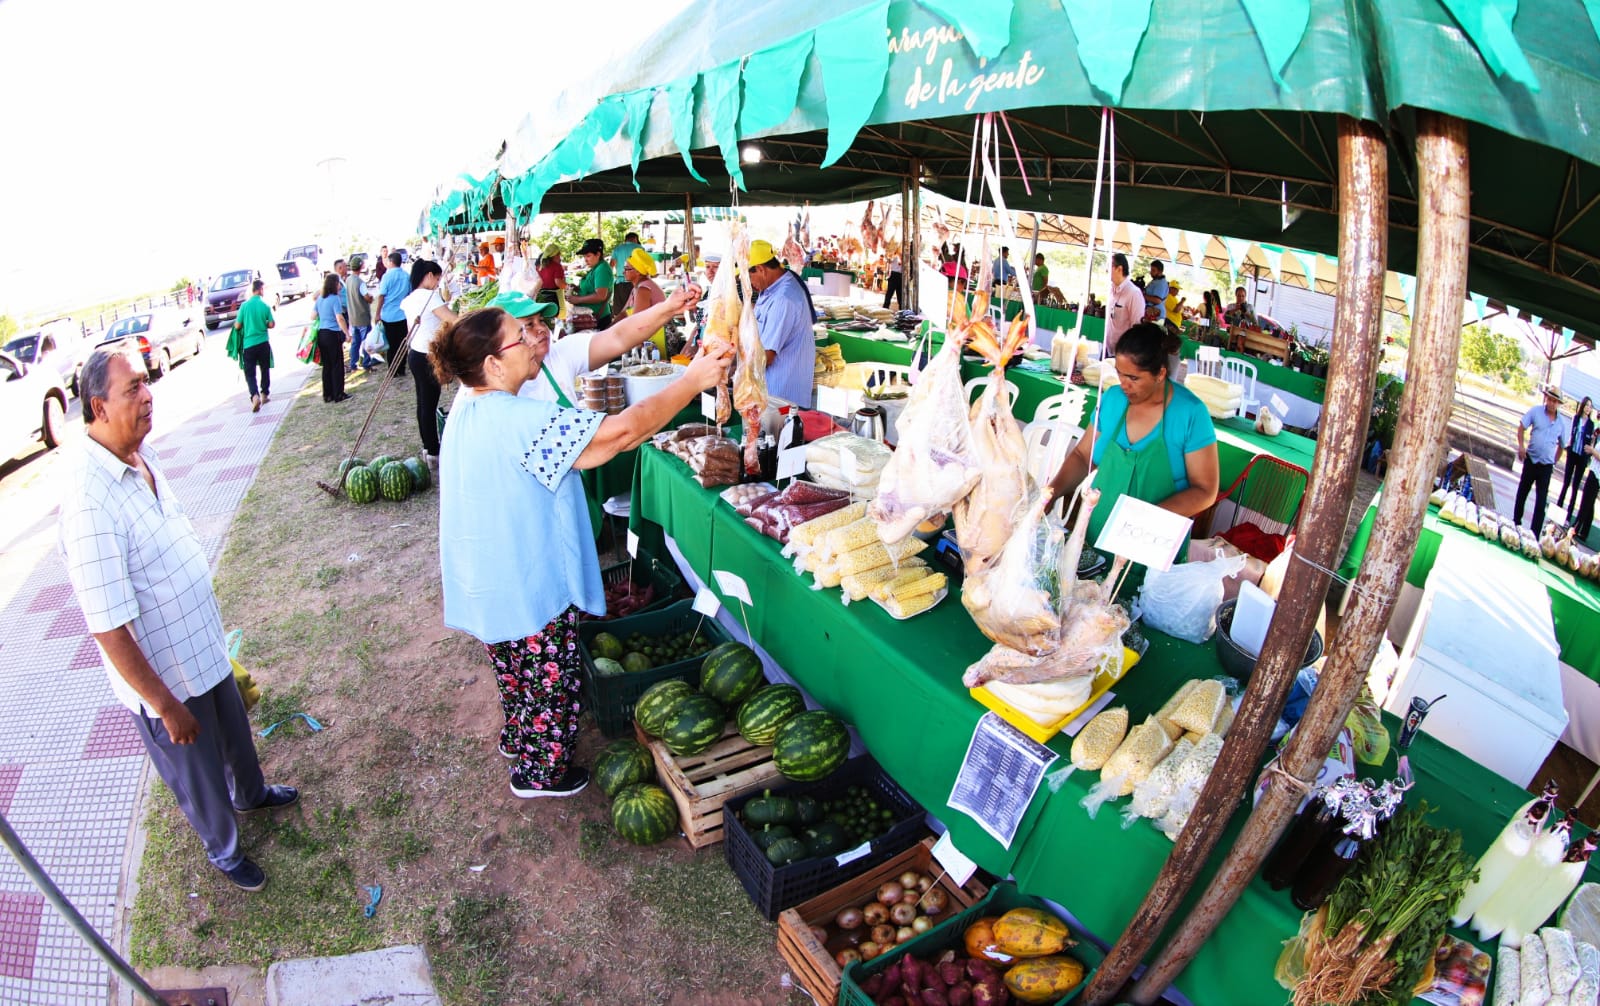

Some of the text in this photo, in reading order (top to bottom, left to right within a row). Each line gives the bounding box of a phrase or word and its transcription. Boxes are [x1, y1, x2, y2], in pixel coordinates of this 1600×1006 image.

[904, 50, 1045, 111] de la gente
